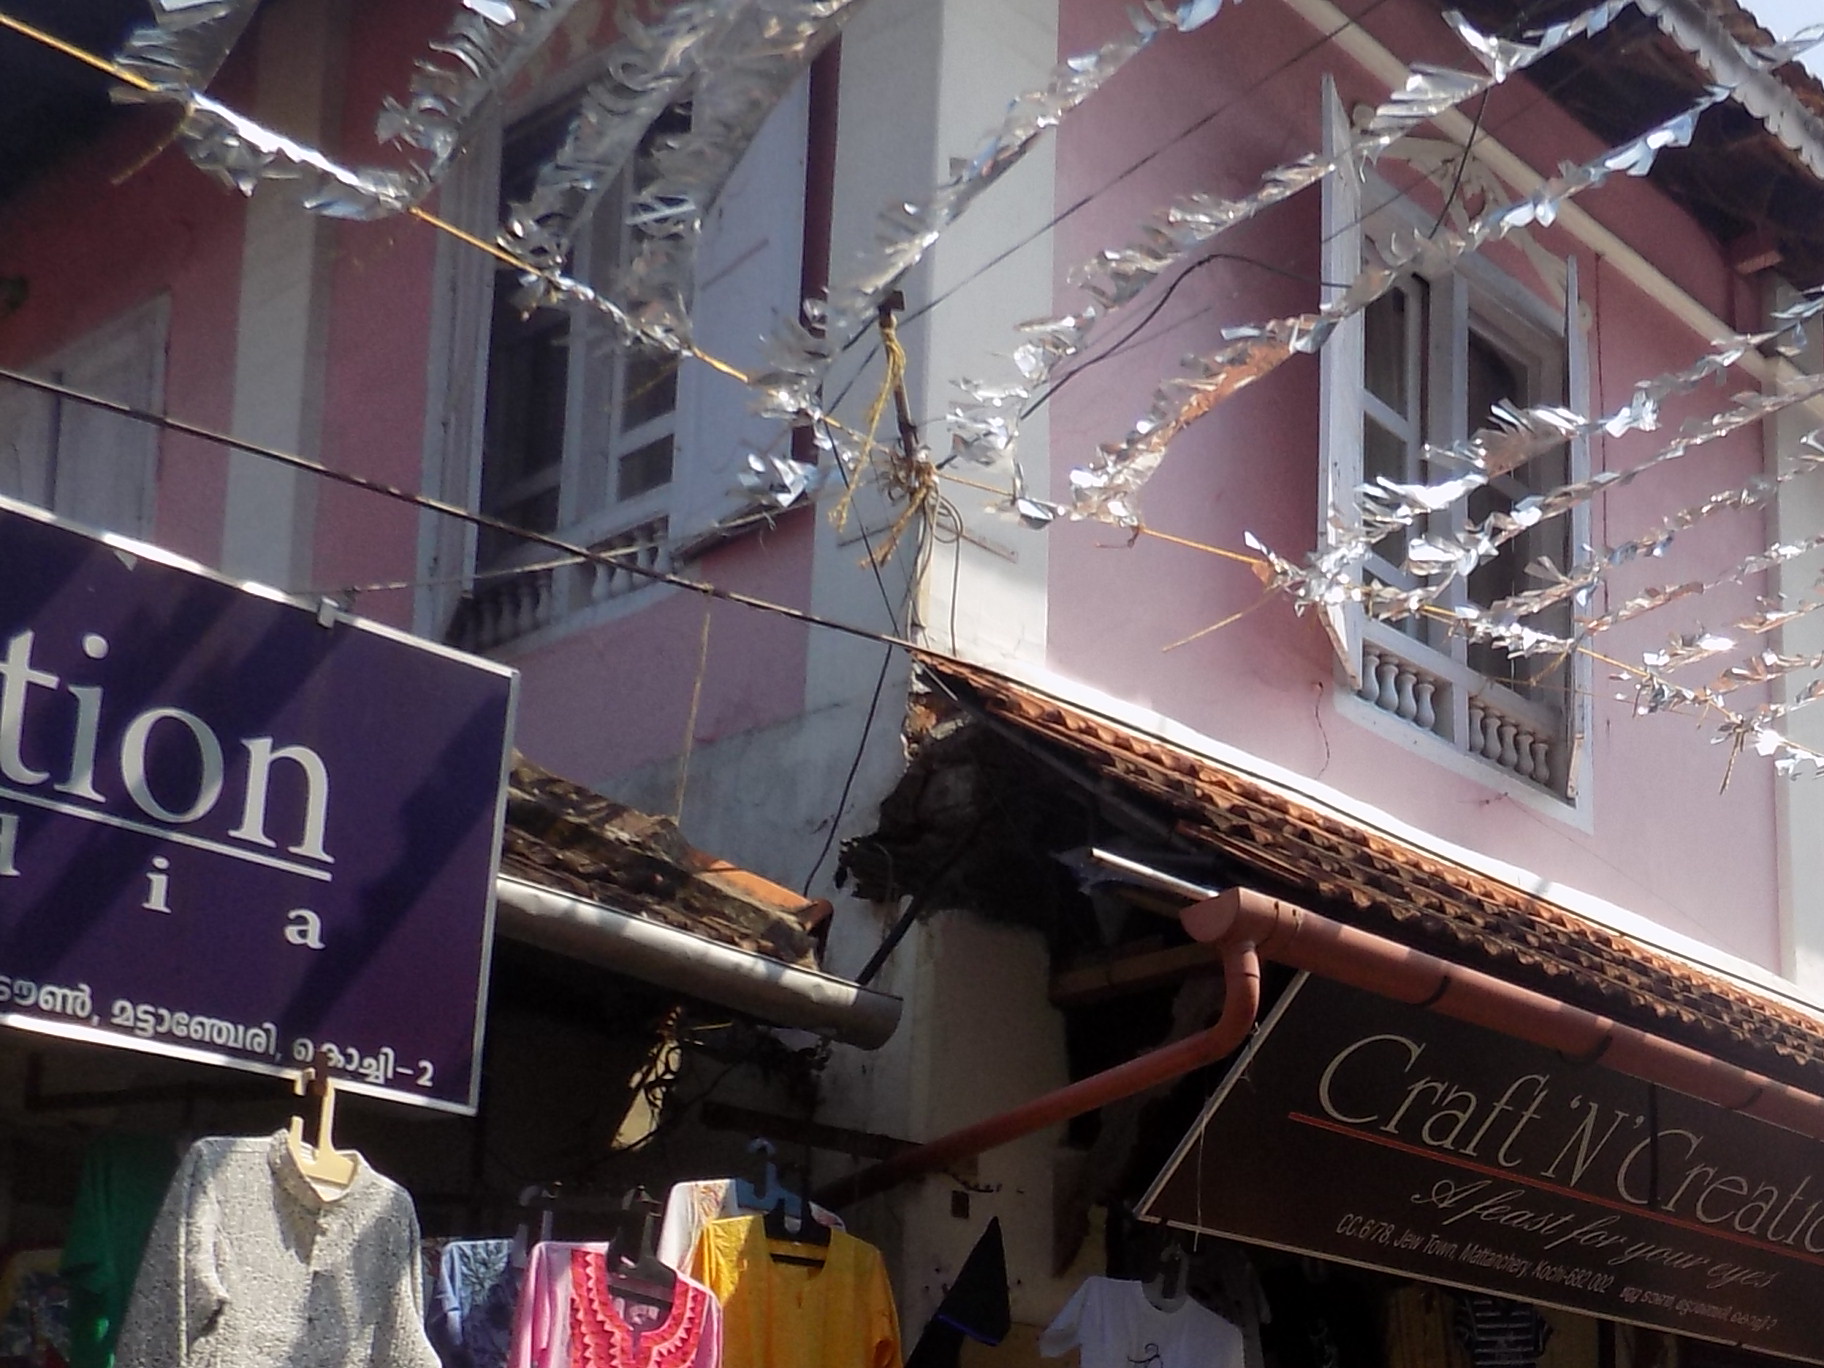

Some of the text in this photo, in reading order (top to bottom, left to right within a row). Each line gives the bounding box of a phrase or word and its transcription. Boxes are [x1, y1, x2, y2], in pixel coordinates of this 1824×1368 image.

[1318, 1033, 1550, 1168] Craft
[1393, 1228, 1425, 1250] Jew
[1441, 1187, 1571, 1236] feast
[1543, 1213, 1629, 1251] for
[1606, 1241, 1711, 1270] your
[1705, 1262, 1781, 1290] eyes
